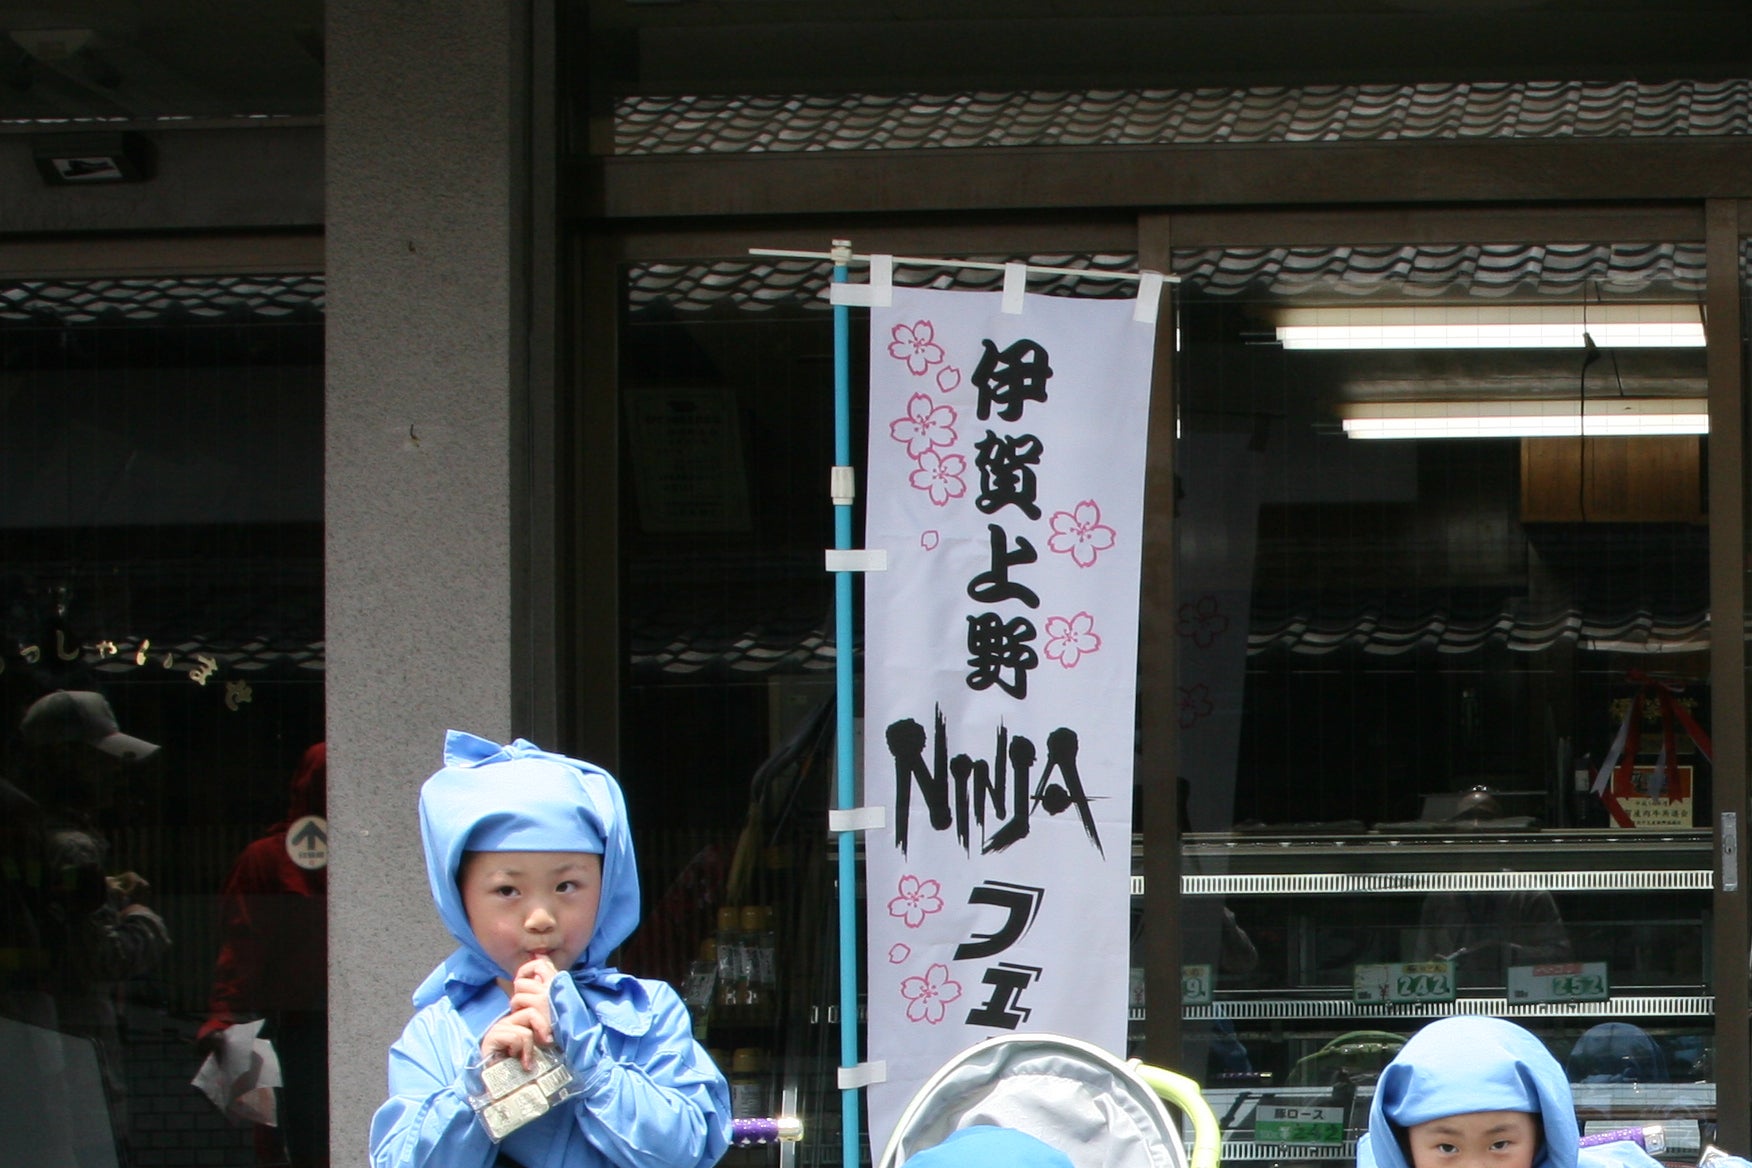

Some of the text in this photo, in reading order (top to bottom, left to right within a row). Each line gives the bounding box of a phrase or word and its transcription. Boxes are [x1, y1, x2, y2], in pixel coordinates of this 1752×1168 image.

[966, 338, 1053, 699] 伊賀上野
[0, 630, 254, 712] っしゃいませ
[885, 701, 1112, 862] NINJA
[953, 880, 1046, 1040] フェ
